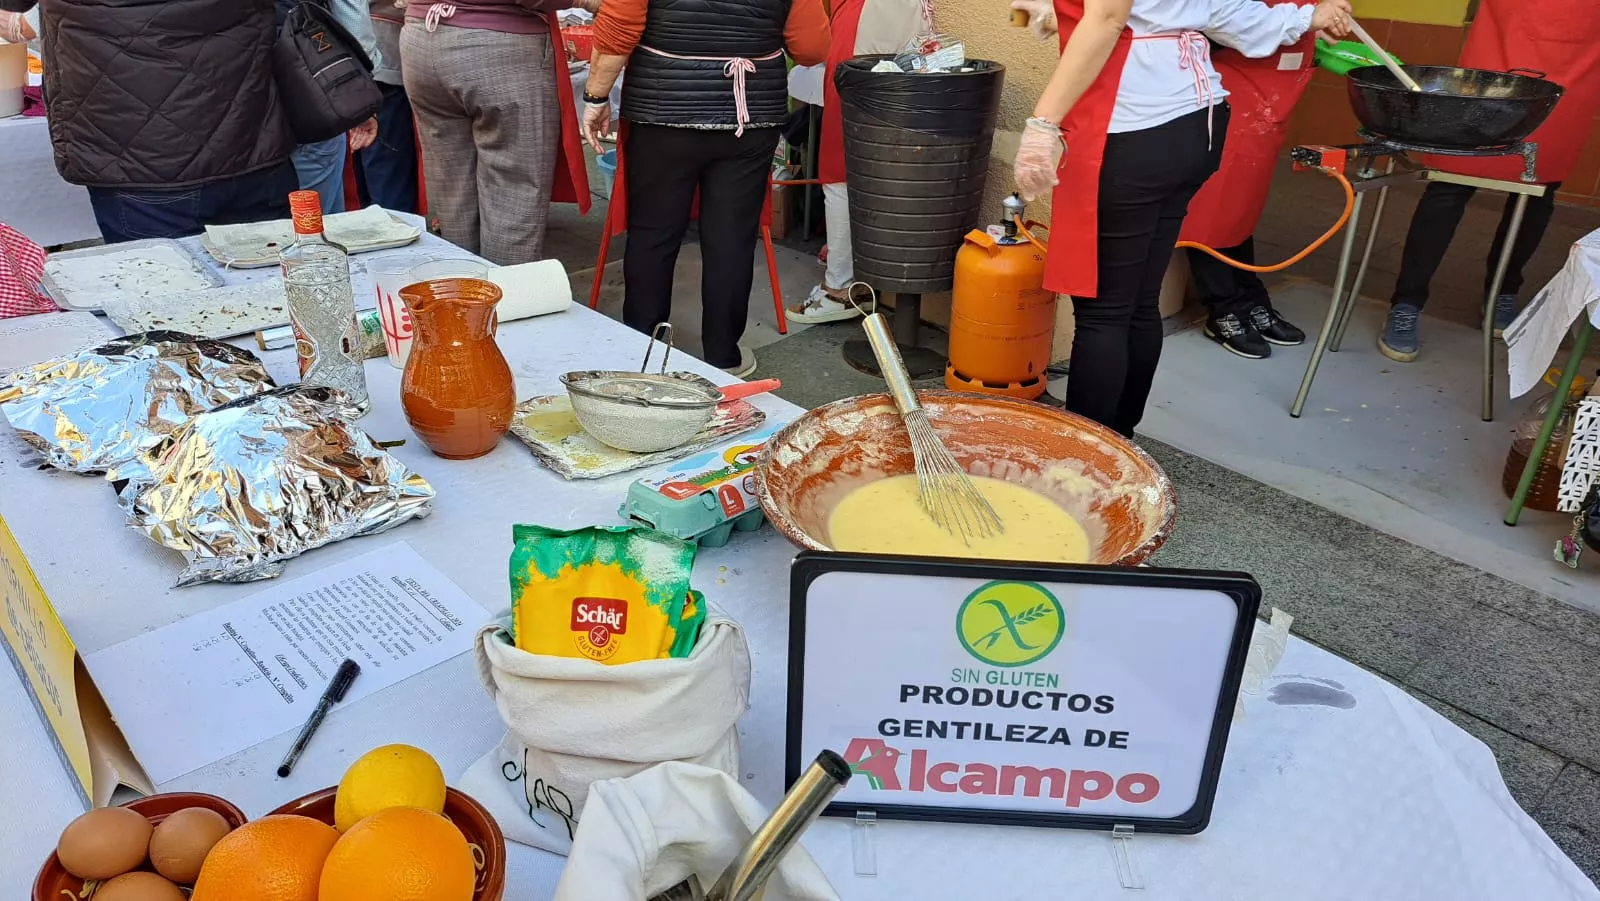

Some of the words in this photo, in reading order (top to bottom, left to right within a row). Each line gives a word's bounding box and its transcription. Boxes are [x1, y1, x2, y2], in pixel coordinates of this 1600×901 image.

[723, 490, 735, 506] L
[576, 603, 624, 630] Schär
[577, 635, 618, 657] GLUTEN-FREE
[951, 668, 981, 684] SIN
[985, 670, 1060, 688] GLUTEN
[899, 684, 1115, 715] PRODUCTOS
[878, 718, 1072, 746] GENTILEZA
[1083, 729, 1130, 749] DE
[843, 737, 1161, 808] Alcampo
